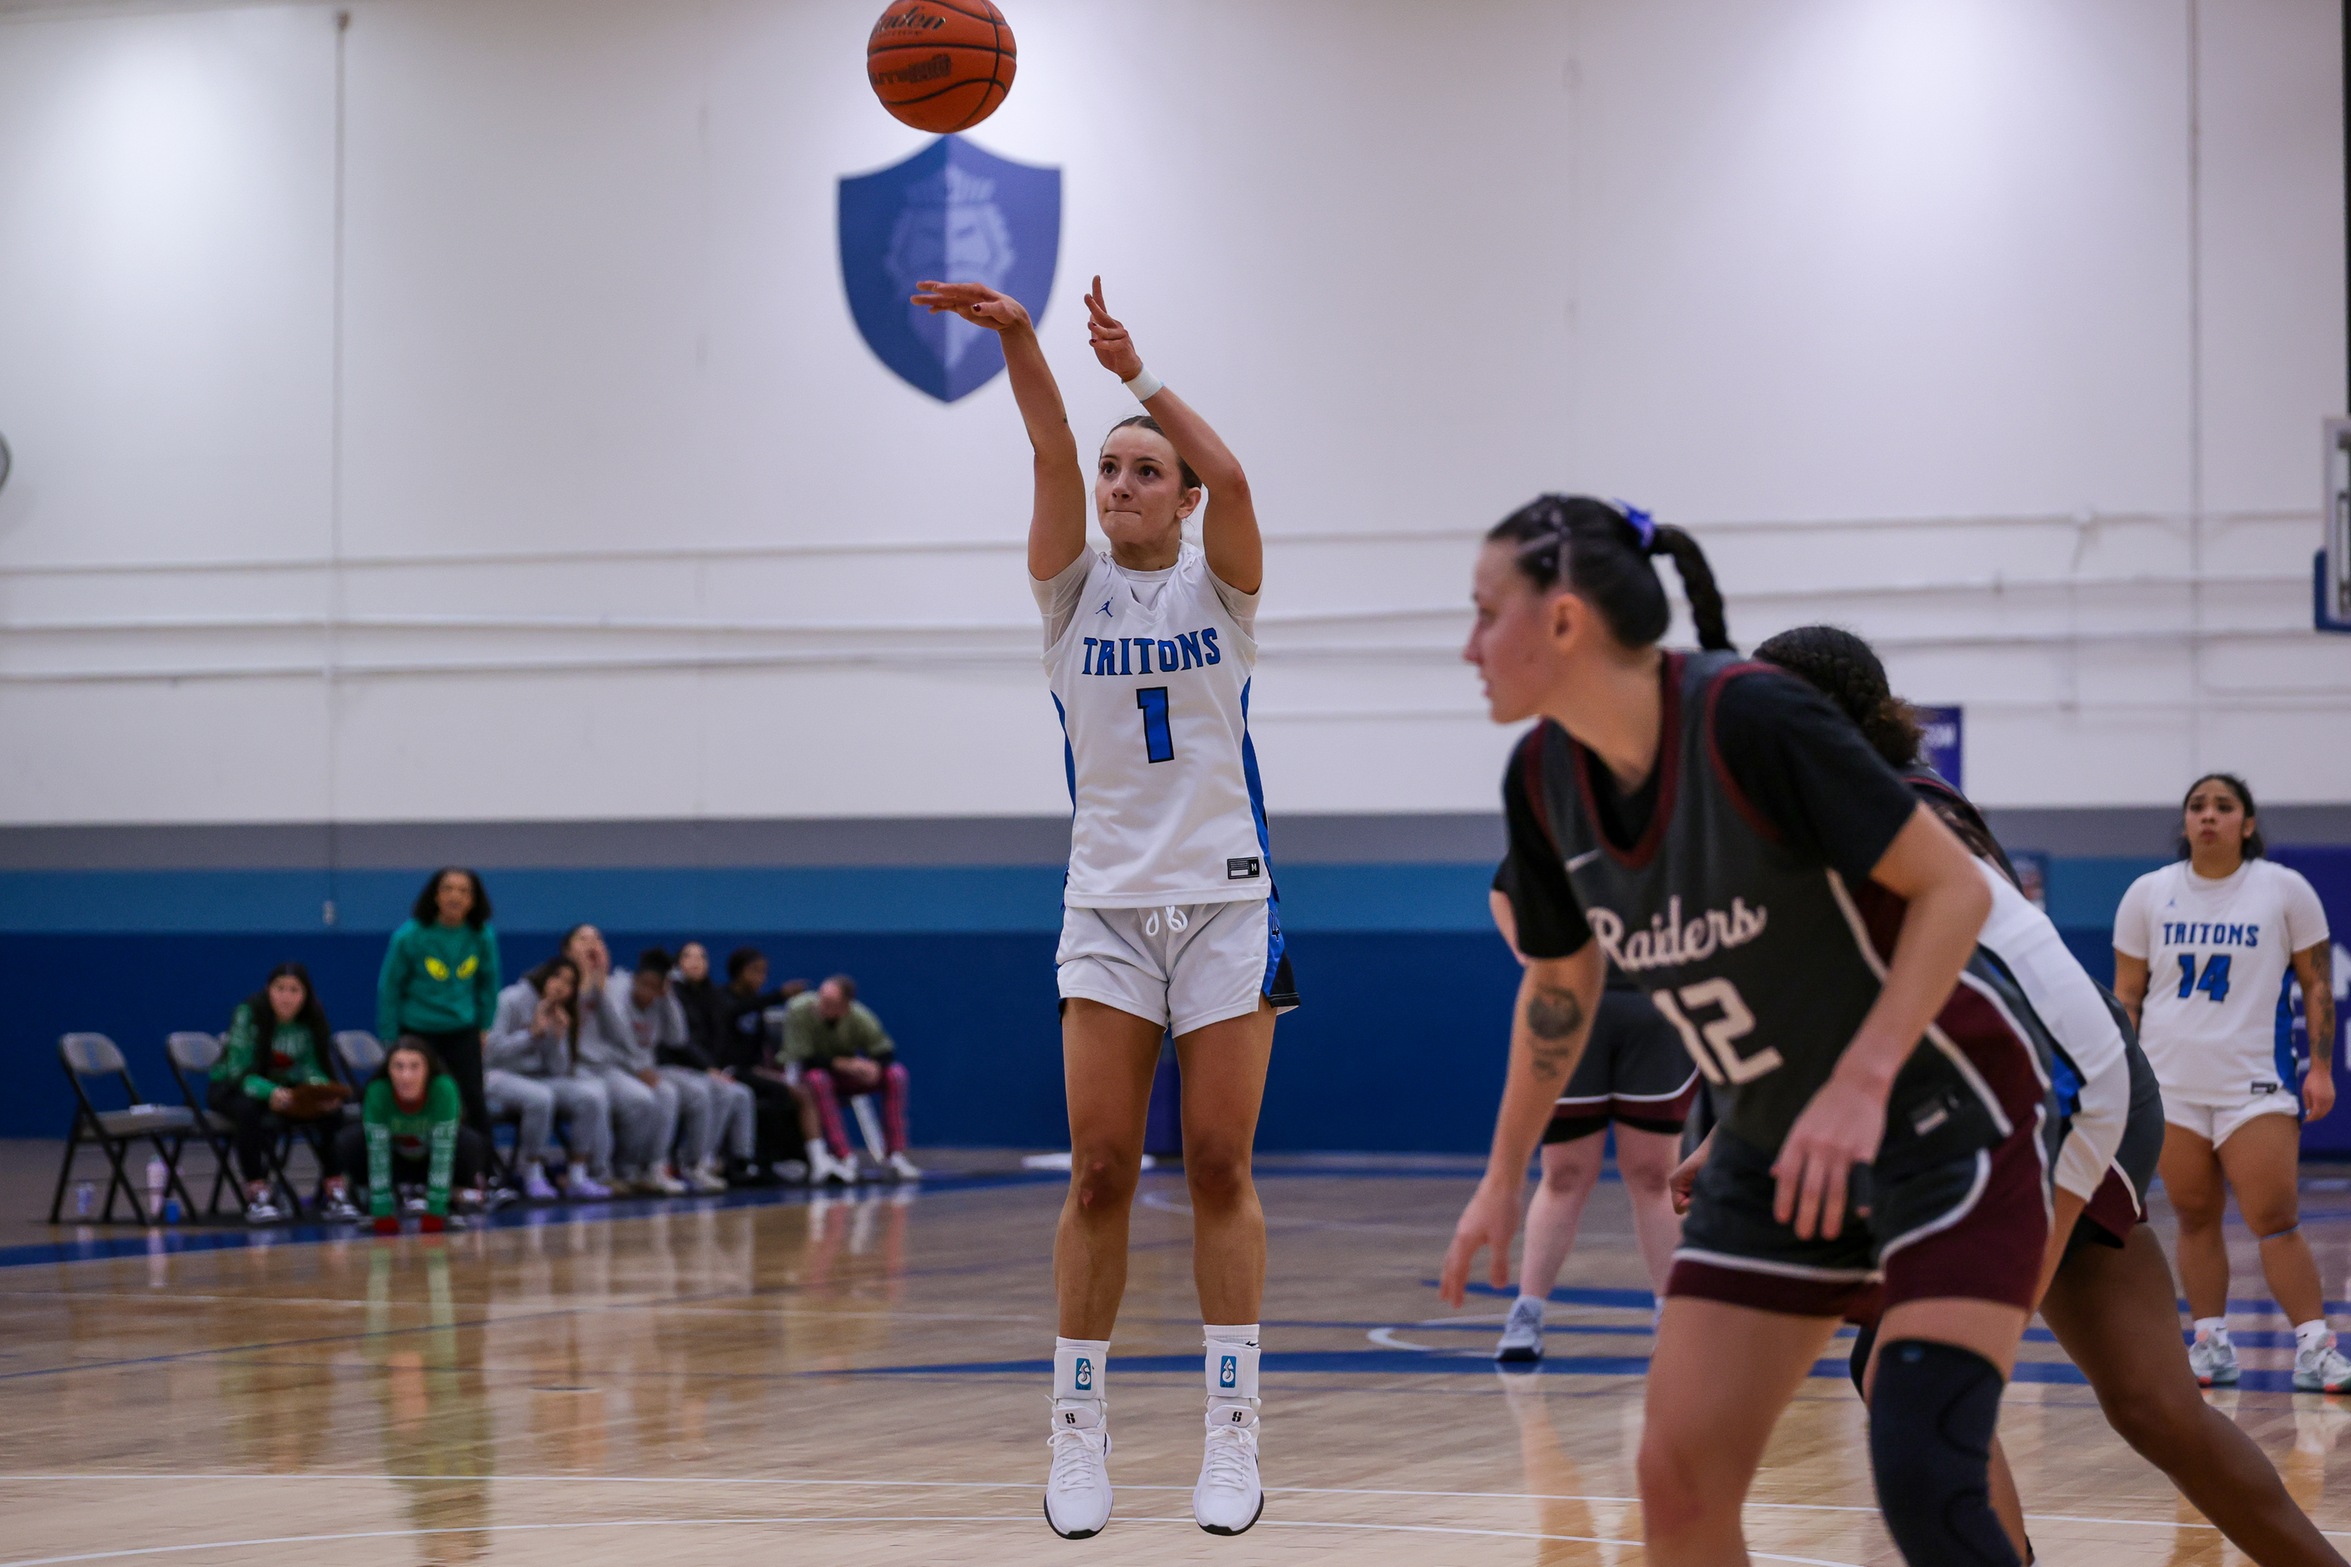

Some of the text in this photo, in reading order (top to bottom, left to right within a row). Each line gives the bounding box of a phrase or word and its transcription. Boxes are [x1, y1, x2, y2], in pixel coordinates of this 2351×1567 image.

[1081, 627, 1221, 676] TRITONS
[1136, 686, 1175, 764] 1
[1586, 894, 1768, 970] Raiders
[2162, 922, 2259, 948] TRITONS
[2177, 953, 2232, 1004] 14
[1652, 976, 1784, 1085] 12
